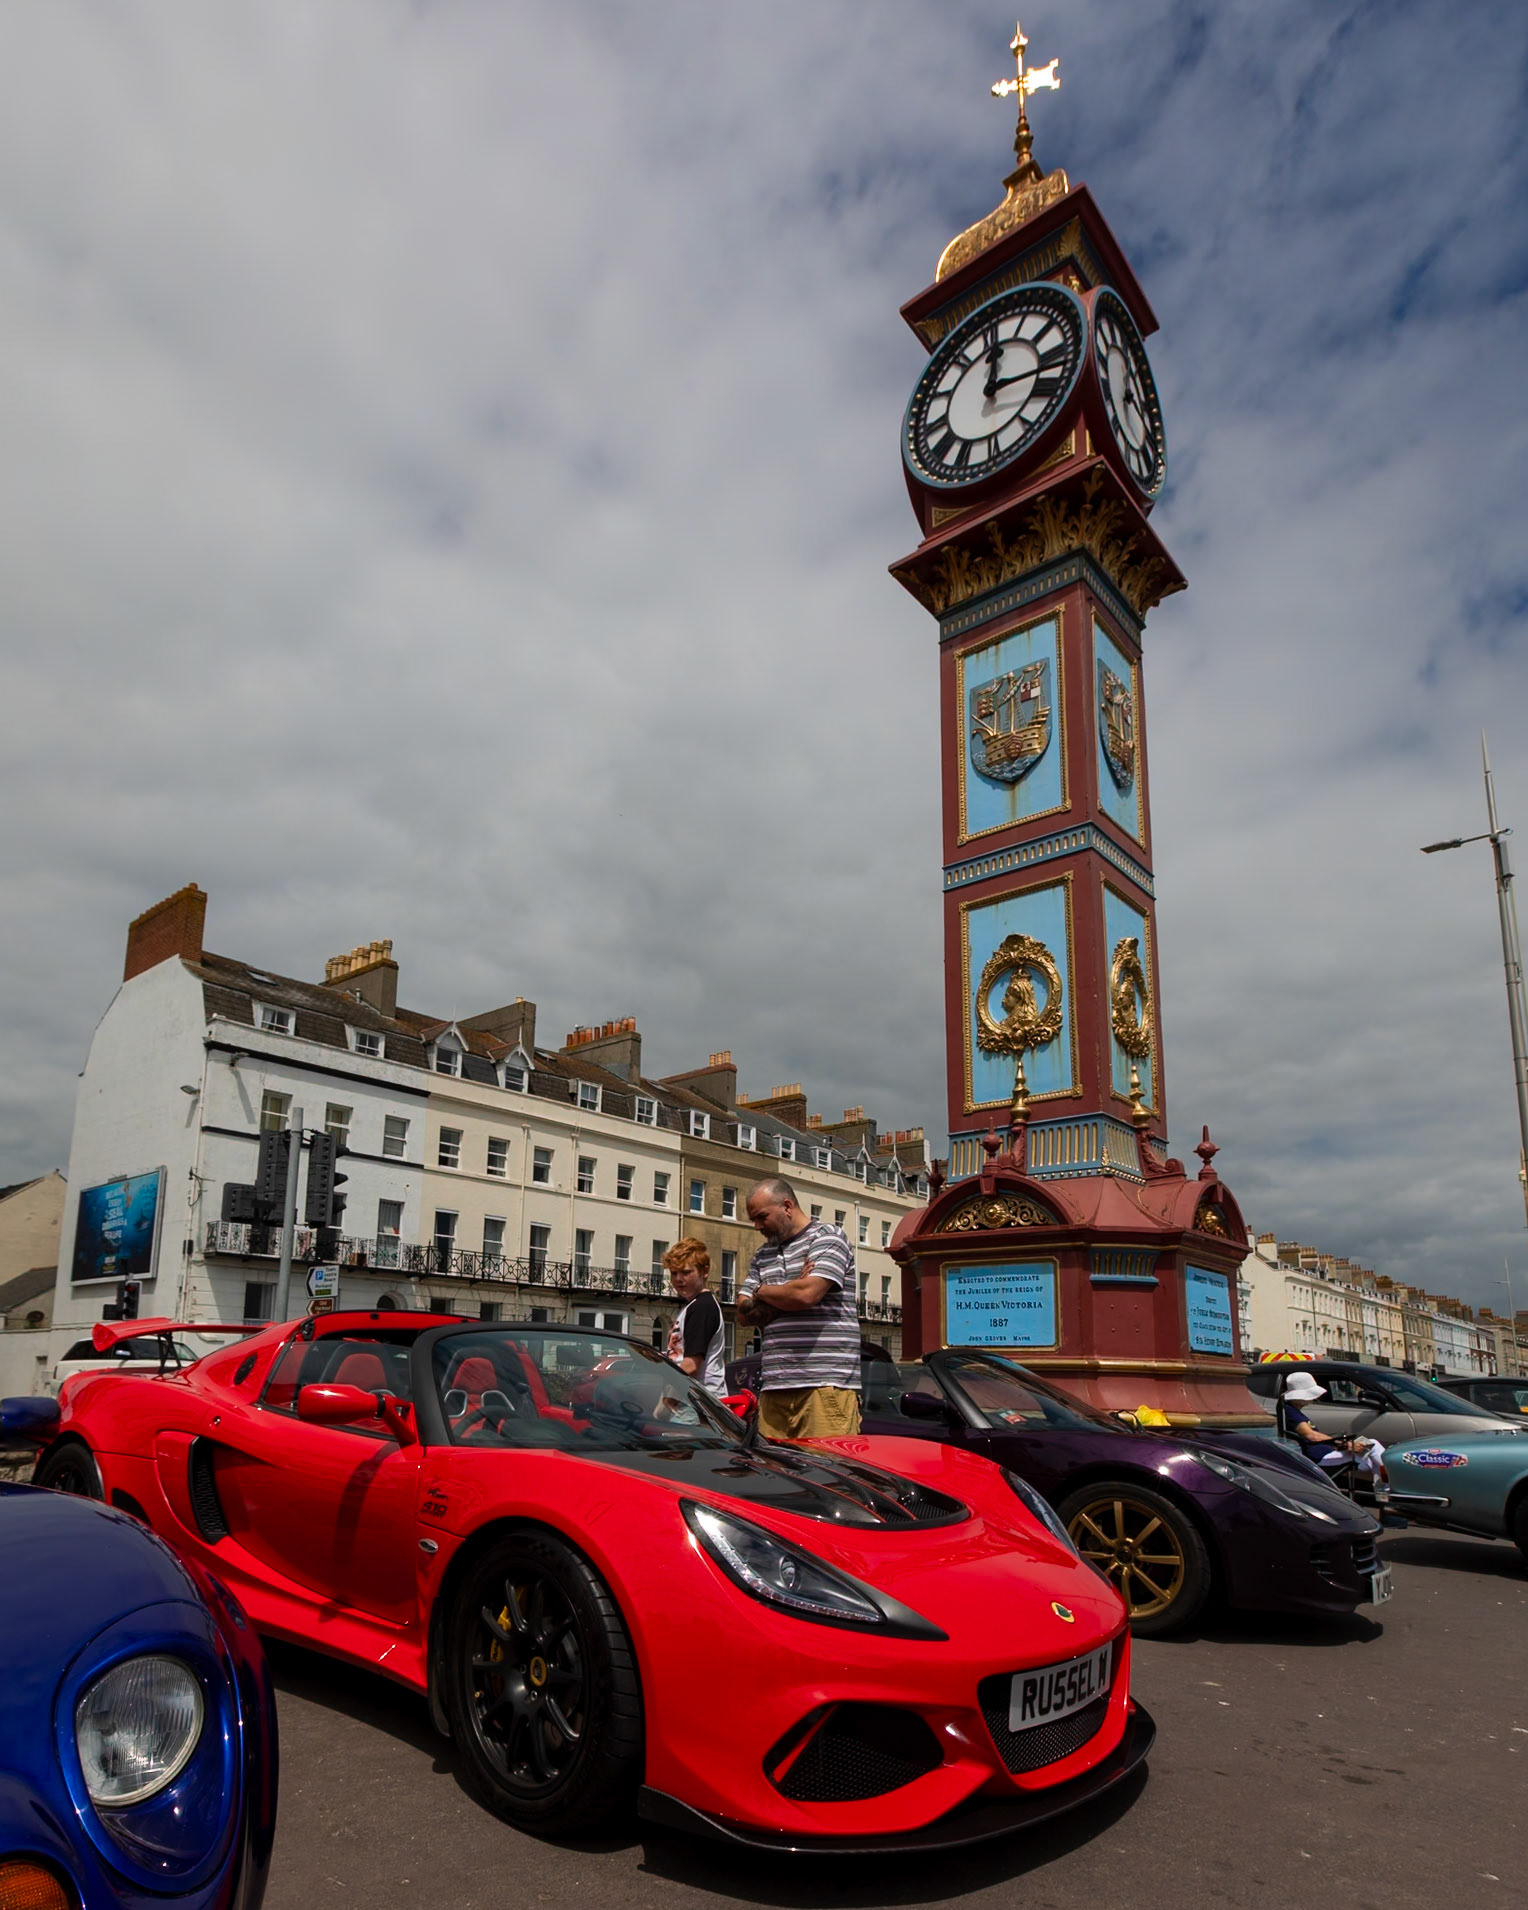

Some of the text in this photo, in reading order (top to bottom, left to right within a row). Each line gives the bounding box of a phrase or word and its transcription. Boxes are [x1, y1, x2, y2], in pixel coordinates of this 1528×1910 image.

[958, 1276, 985, 1284] ERECTED
[994, 1275, 1040, 1283] COMMEMORATE
[956, 1300, 1043, 1310] H.M. QUEEN VICTORIA
[990, 1318, 1009, 1328] 1887
[1418, 1454, 1451, 1464] Classic
